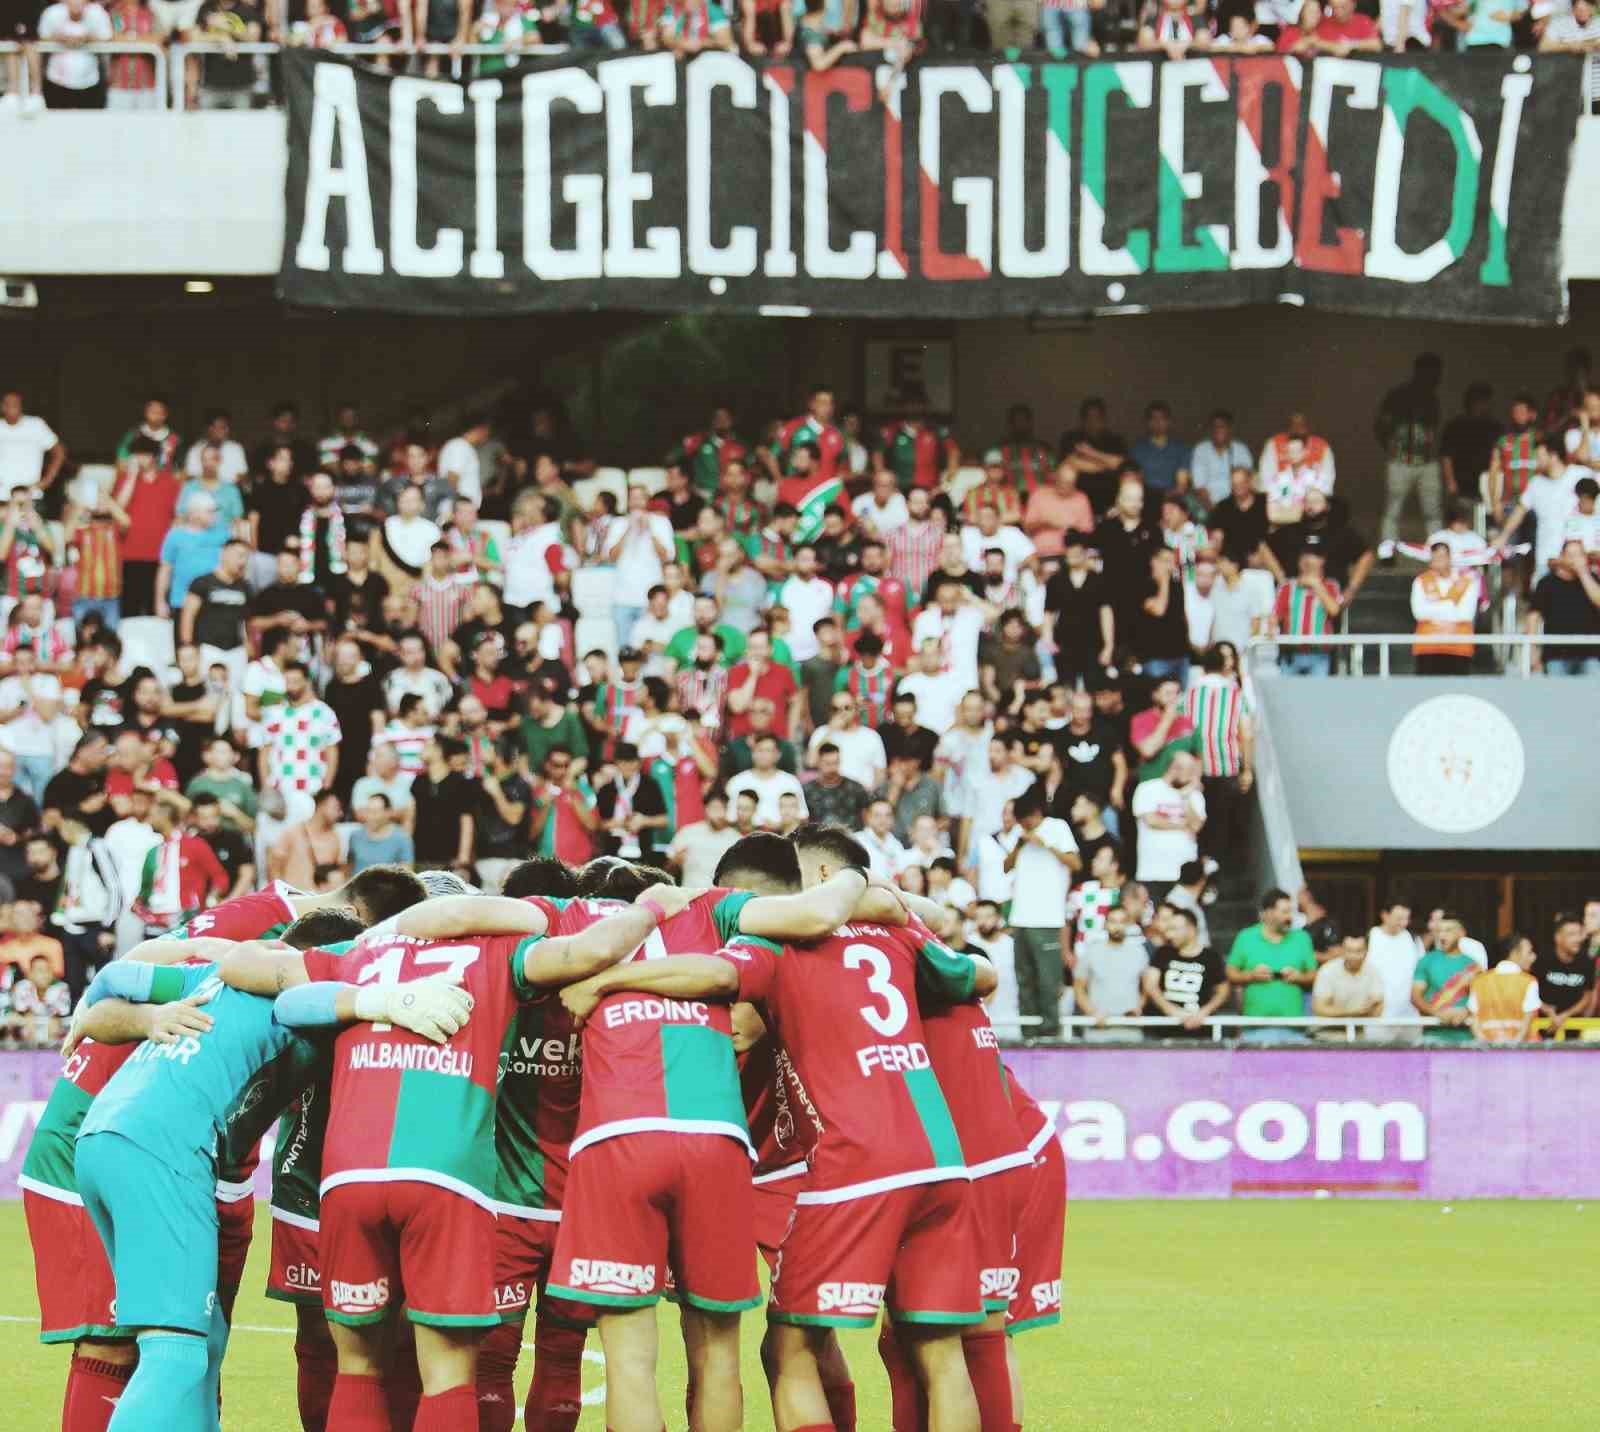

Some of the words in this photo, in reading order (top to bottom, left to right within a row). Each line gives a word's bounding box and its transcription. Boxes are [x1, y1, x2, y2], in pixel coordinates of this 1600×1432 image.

[296, 62, 505, 279] ACI
[604, 998, 710, 1029] ERDİNÇ
[843, 943, 909, 1038] 3
[349, 1041, 474, 1079] NALBANTOĞLU
